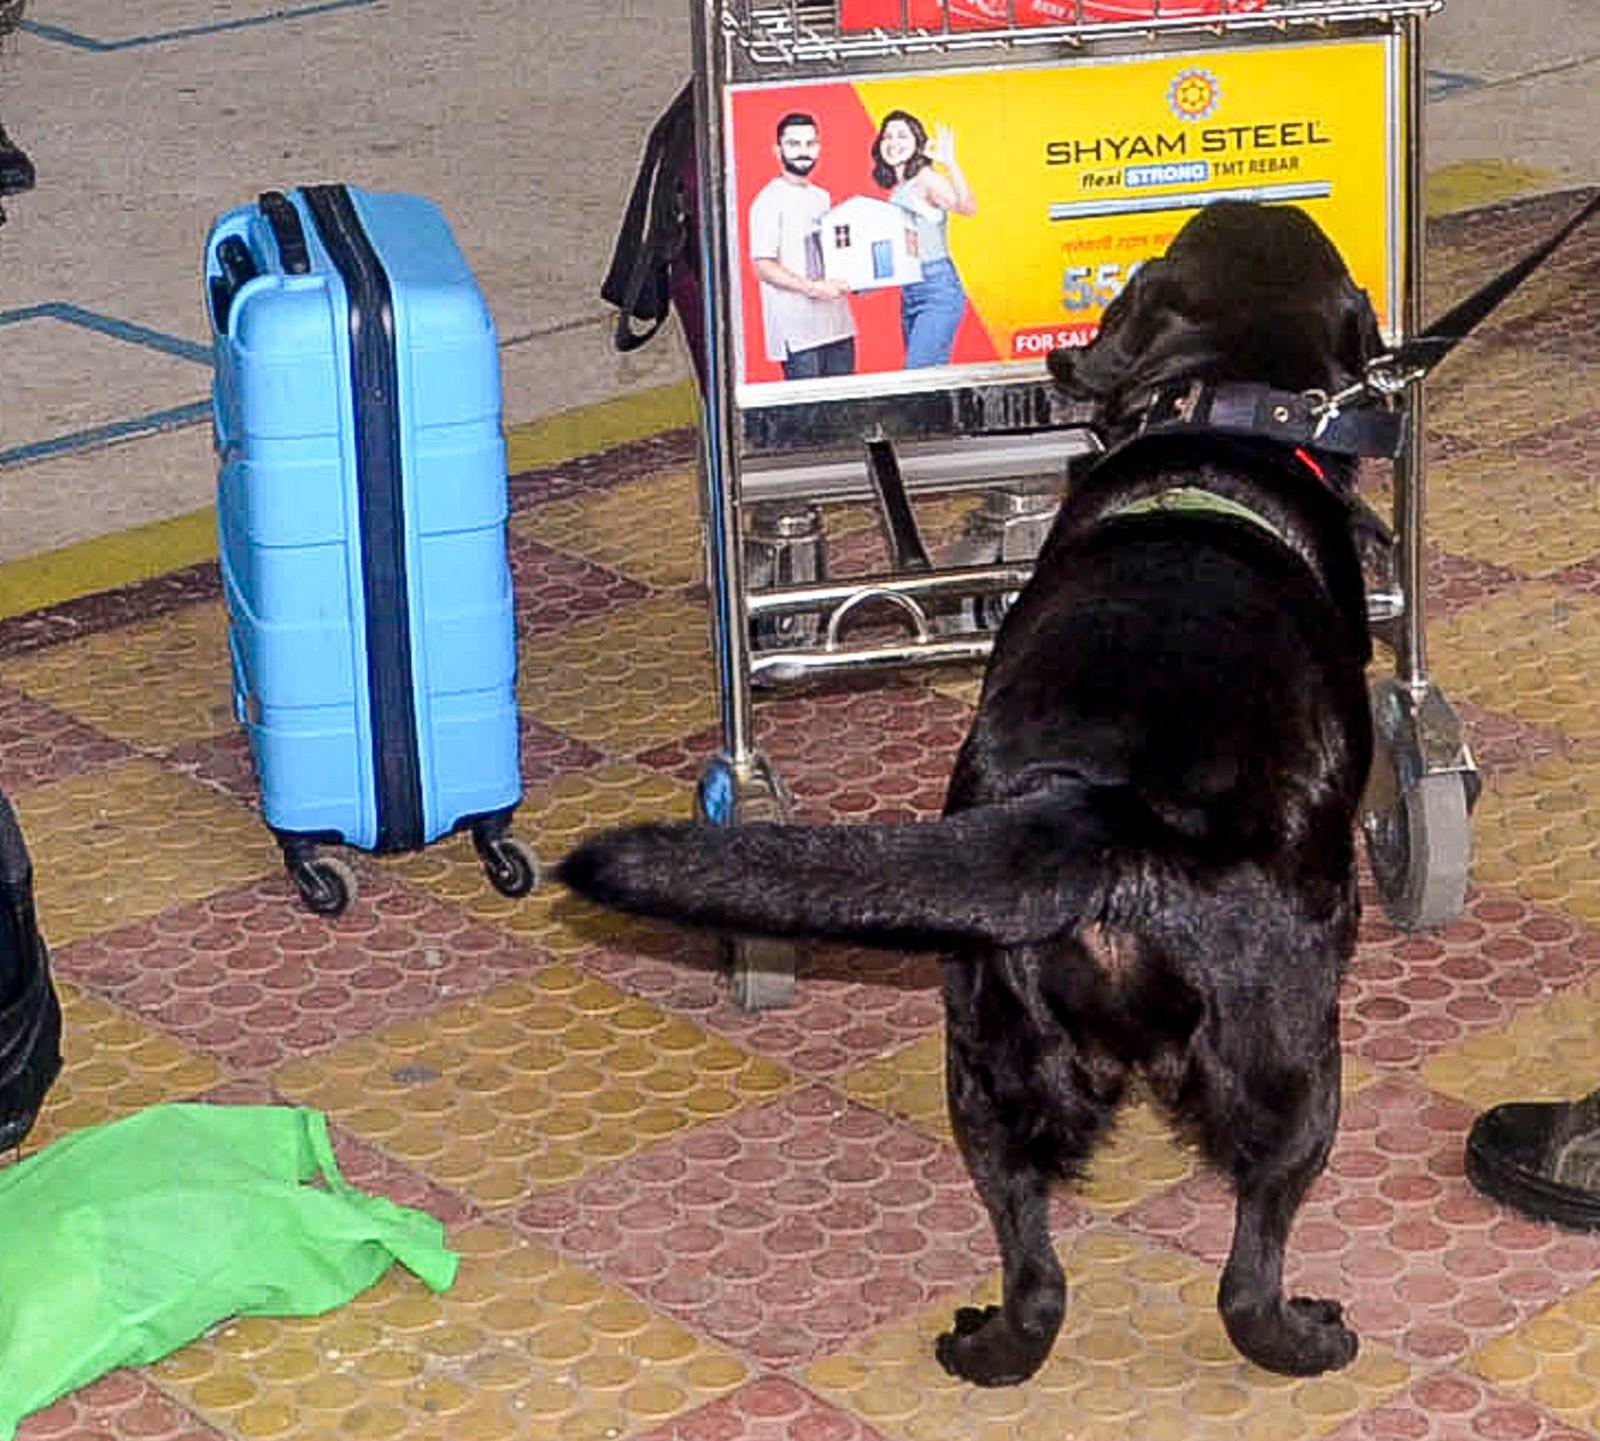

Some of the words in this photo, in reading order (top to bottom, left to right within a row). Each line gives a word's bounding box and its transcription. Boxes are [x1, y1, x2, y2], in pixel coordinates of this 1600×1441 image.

[1045, 132, 1187, 166] SHYAM
[1201, 122, 1330, 153] STEEL
[1081, 170, 1122, 189] flexi
[1126, 163, 1206, 186] STRONG
[1213, 161, 1244, 177] TMT
[1249, 156, 1299, 174] REBAR
[1062, 260, 1143, 311] 55
[1016, 333, 1054, 353] FOR
